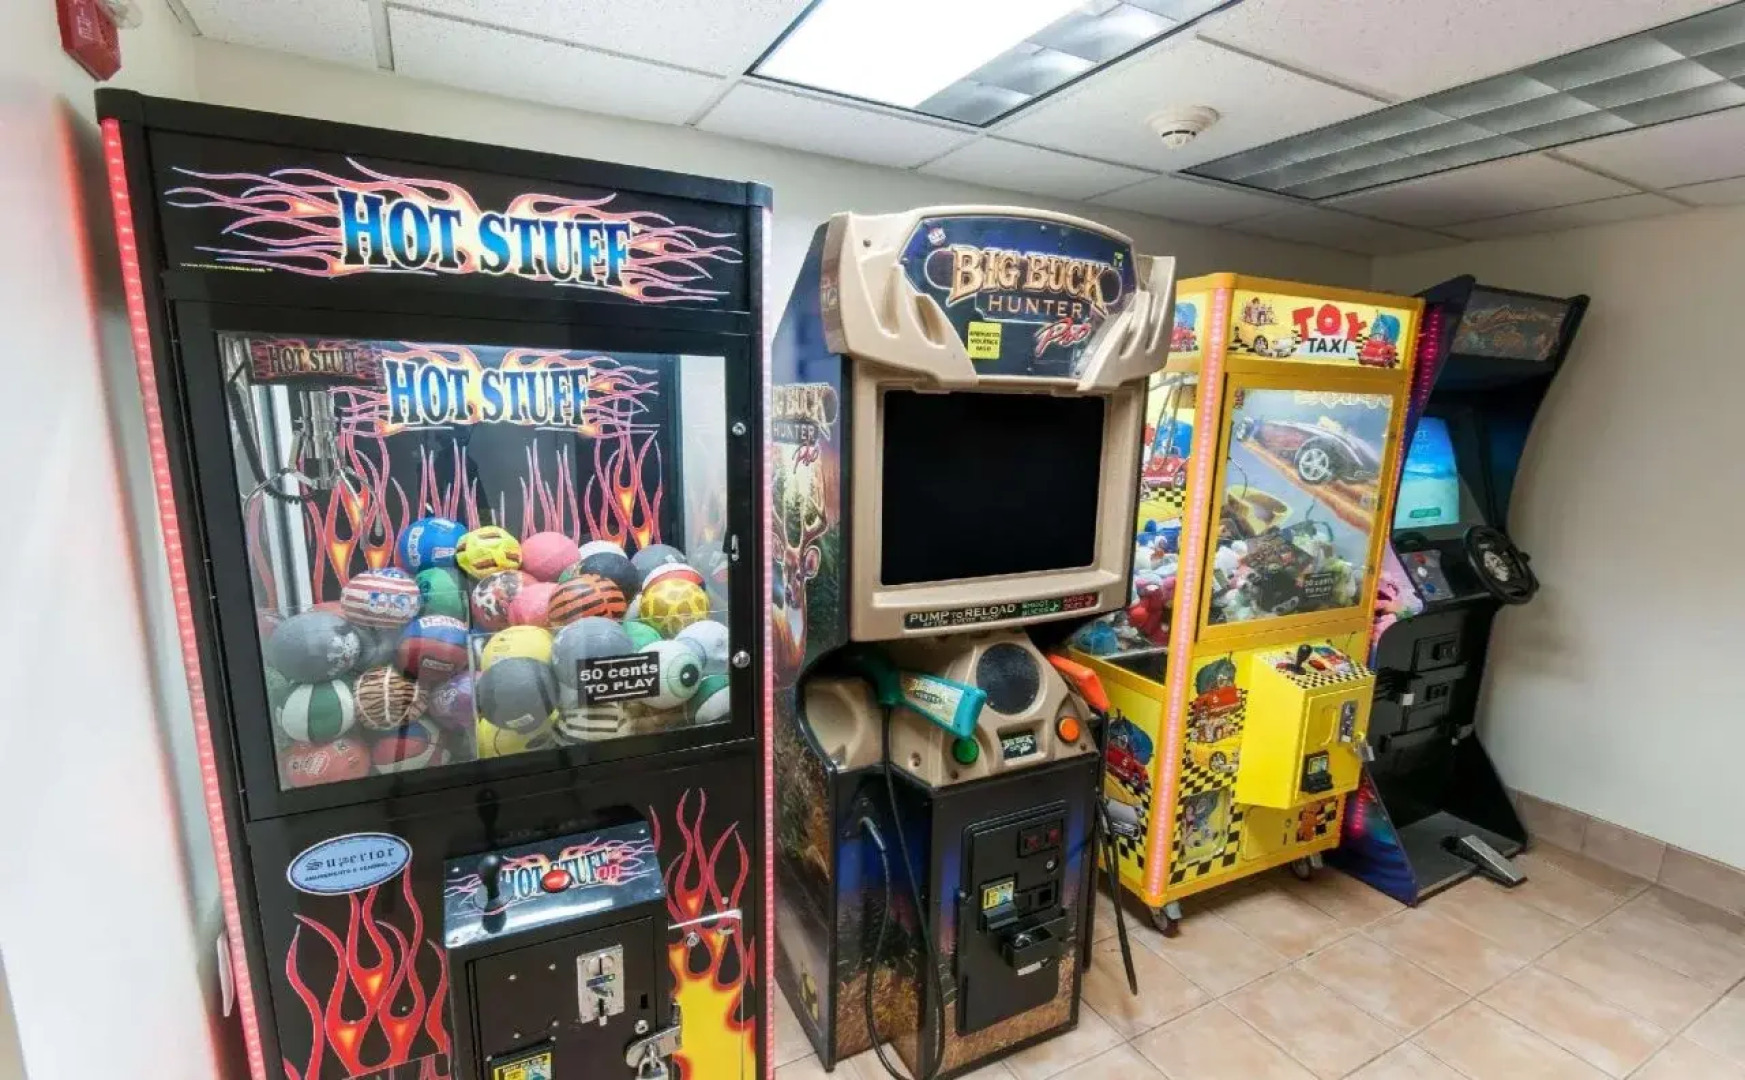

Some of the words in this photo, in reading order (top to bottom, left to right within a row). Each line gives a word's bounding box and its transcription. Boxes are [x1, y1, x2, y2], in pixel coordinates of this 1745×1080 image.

[336, 188, 462, 270] HOT
[478, 212, 632, 287] STUFF
[948, 245, 1020, 304] BIG
[1022, 251, 1107, 317] BUCK
[988, 295, 1083, 318] HUNTER
[1292, 304, 1367, 342] TOY
[1308, 338, 1348, 353] TAXI
[267, 345, 306, 374] HOT
[308, 348, 358, 375] STUFF
[383, 358, 469, 424] HOT
[481, 367, 589, 425] STUFF
[910, 611, 949, 622] PUMP
[952, 611, 963, 619] TO
[965, 604, 1015, 617] RELOAD
[580, 669, 603, 682] 50
[607, 662, 658, 679] cents
[585, 682, 608, 694] TO
[613, 677, 655, 691] PLAY
[305, 848, 395, 870] Superior
